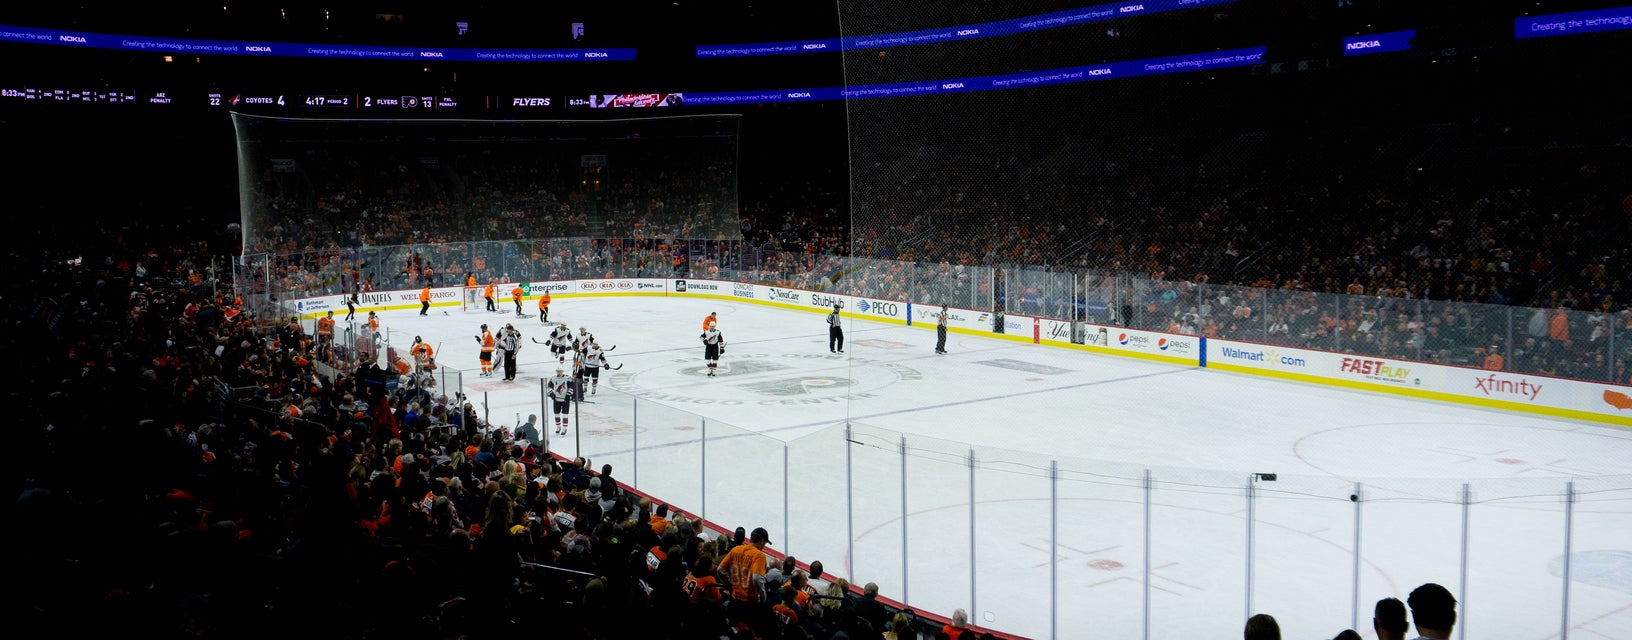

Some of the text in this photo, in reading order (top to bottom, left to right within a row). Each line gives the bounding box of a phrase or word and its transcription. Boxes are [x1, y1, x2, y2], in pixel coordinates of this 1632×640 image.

[1120, 4, 1144, 13] NOKIA
[1531, 16, 1632, 31] Creating the technology
[60, 35, 87, 43] NOKIA
[122, 40, 145, 48] Creating
[156, 42, 184, 51] technology
[1347, 40, 1380, 50] NOKIA
[308, 47, 329, 55] Creating
[1088, 68, 1111, 76] NOKIA
[1145, 63, 1165, 71] Creating
[277, 95, 285, 106] 4
[306, 97, 325, 105] 4:17
[364, 97, 371, 107] 2
[513, 98, 551, 106] FLYERS
[430, 291, 456, 300] FARGO
[733, 289, 754, 298] BUSINESS
[776, 288, 800, 300] NovaCare
[812, 294, 845, 309] StubHub
[872, 301, 898, 317] PECO
[1129, 334, 1149, 344] pepsi
[1169, 340, 1190, 349] pepsi
[1222, 347, 1306, 367] Walmart com
[1474, 373, 1543, 400] xfinity
